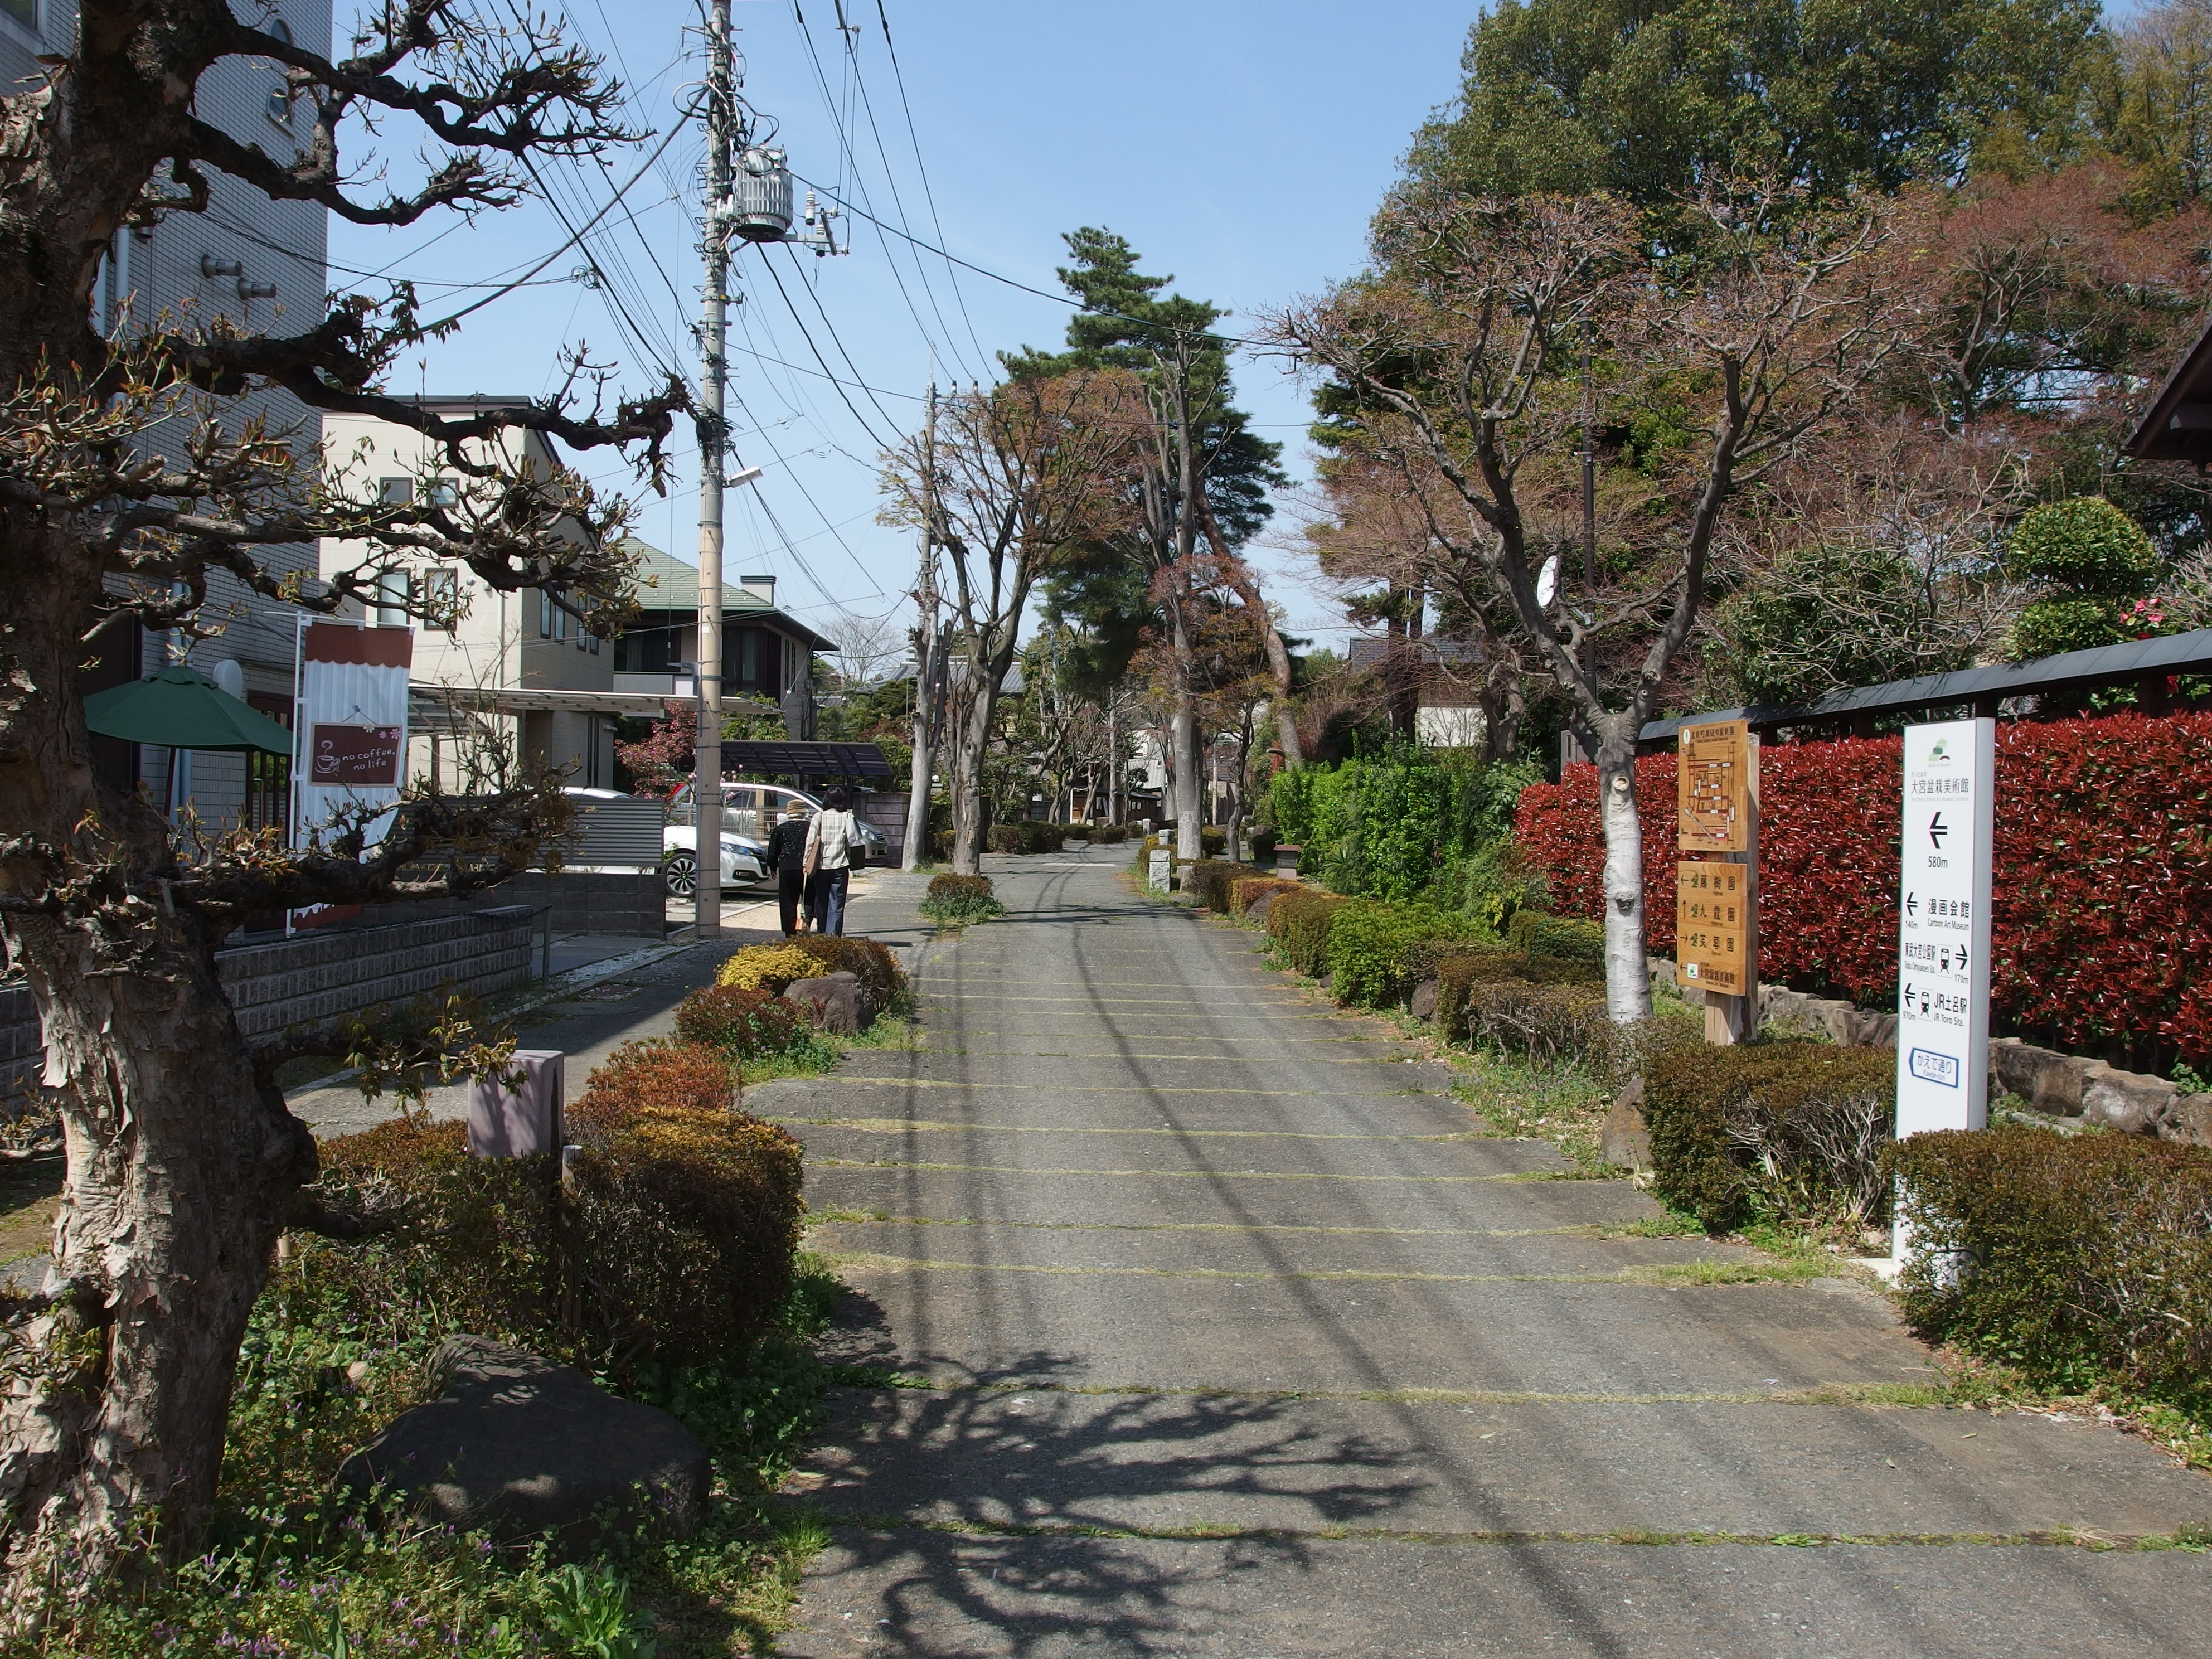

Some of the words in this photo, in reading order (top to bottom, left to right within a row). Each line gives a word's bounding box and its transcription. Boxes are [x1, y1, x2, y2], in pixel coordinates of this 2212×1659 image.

[358, 748, 395, 759] coffee,
[368, 759, 386, 768] life
[1911, 777, 1969, 794] 大宮盆栽美術館
[1928, 856, 1948, 868] 580m
[1928, 898, 1970, 918] 漫画会館
[1905, 920, 1918, 929] 140m
[1928, 918, 1943, 928] Cartoon
[1952, 920, 1969, 930] Museum
[1904, 942, 1936, 961] 東武大宮公園駅
[1954, 974, 1968, 984] 170m
[1903, 1011, 1916, 1021] 970m
[1934, 1013, 1939, 1021] JR
[1941, 1013, 1953, 1024] Toro
[1954, 1017, 1964, 1027] Sta.
[1917, 1054, 1952, 1074] かえで通り
